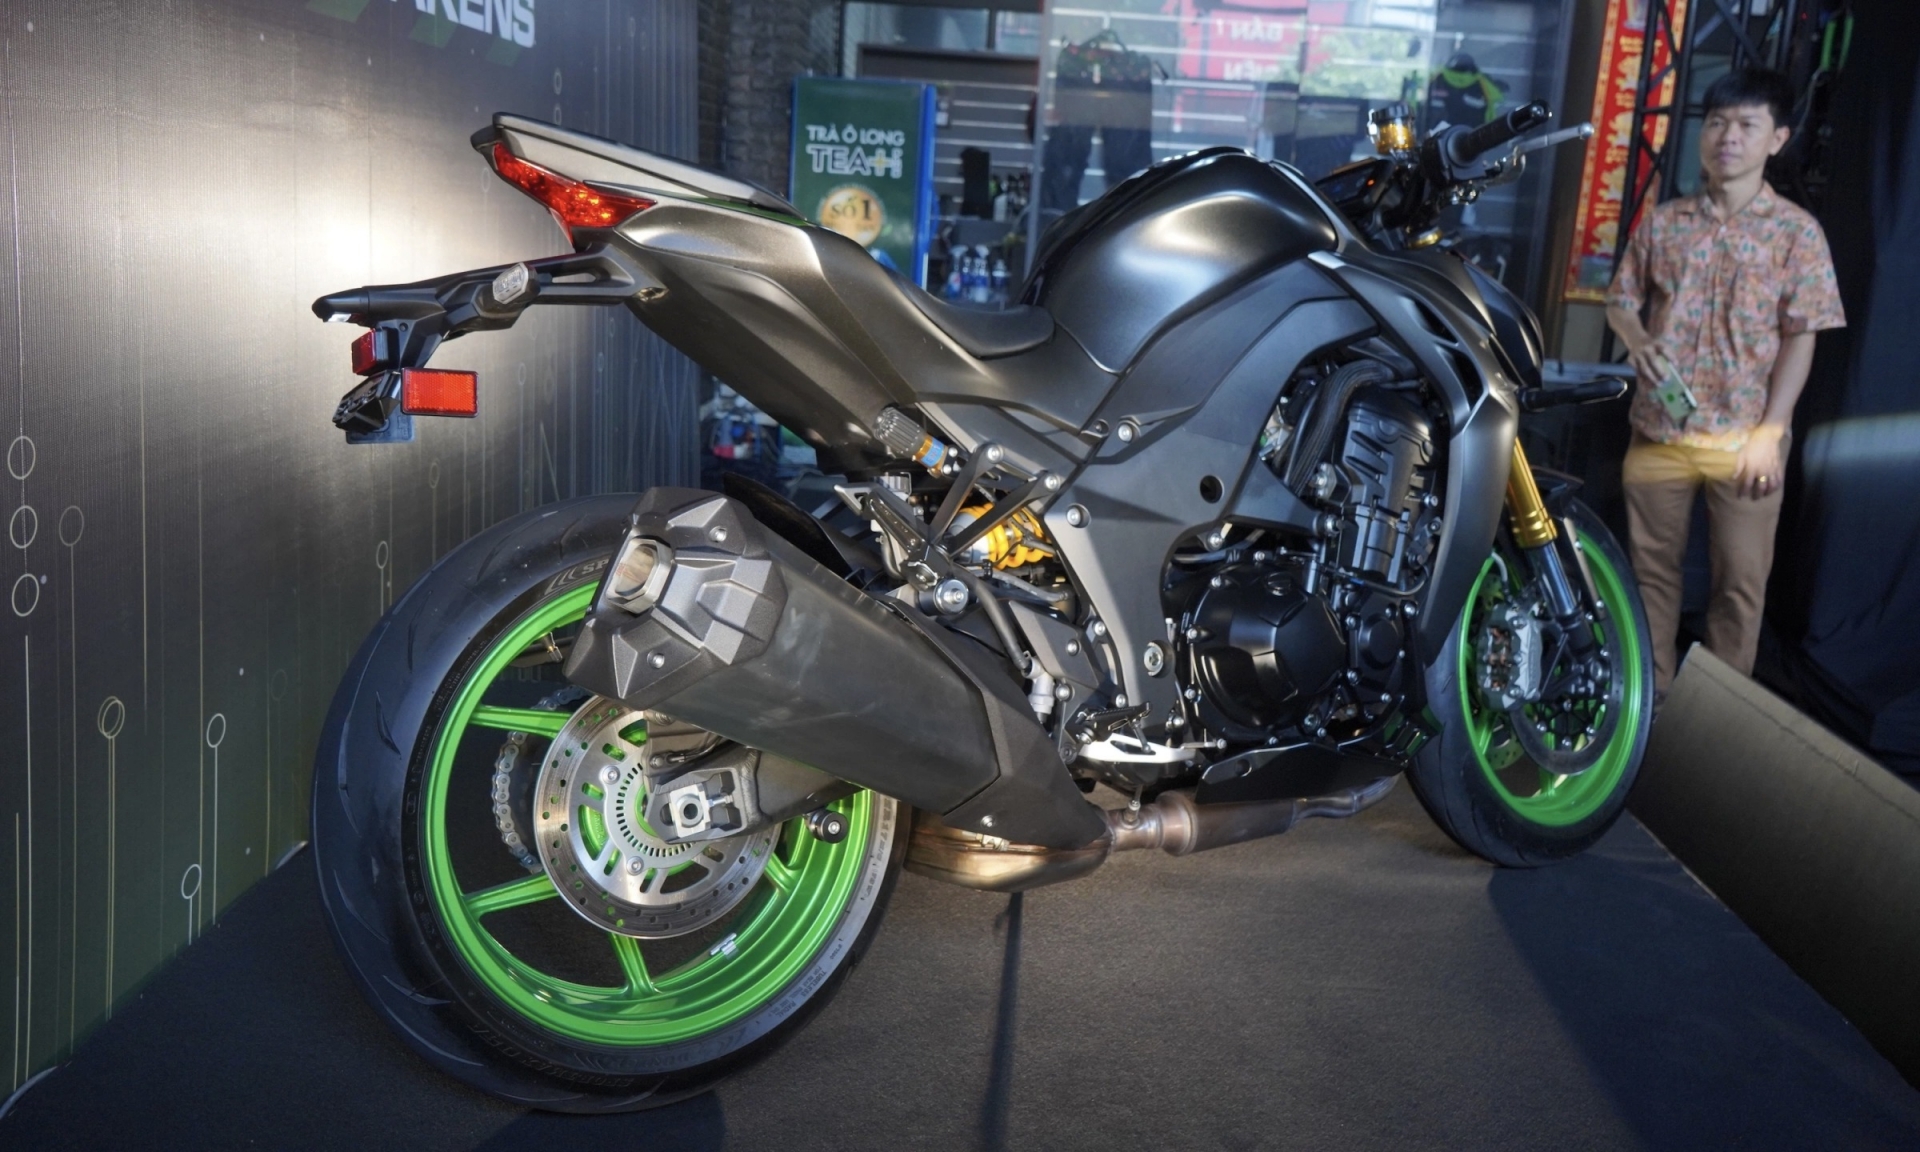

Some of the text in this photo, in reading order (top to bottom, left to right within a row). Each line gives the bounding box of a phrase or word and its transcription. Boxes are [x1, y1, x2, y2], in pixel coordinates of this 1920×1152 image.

[805, 122, 905, 147] TRÀ Ô LONG
